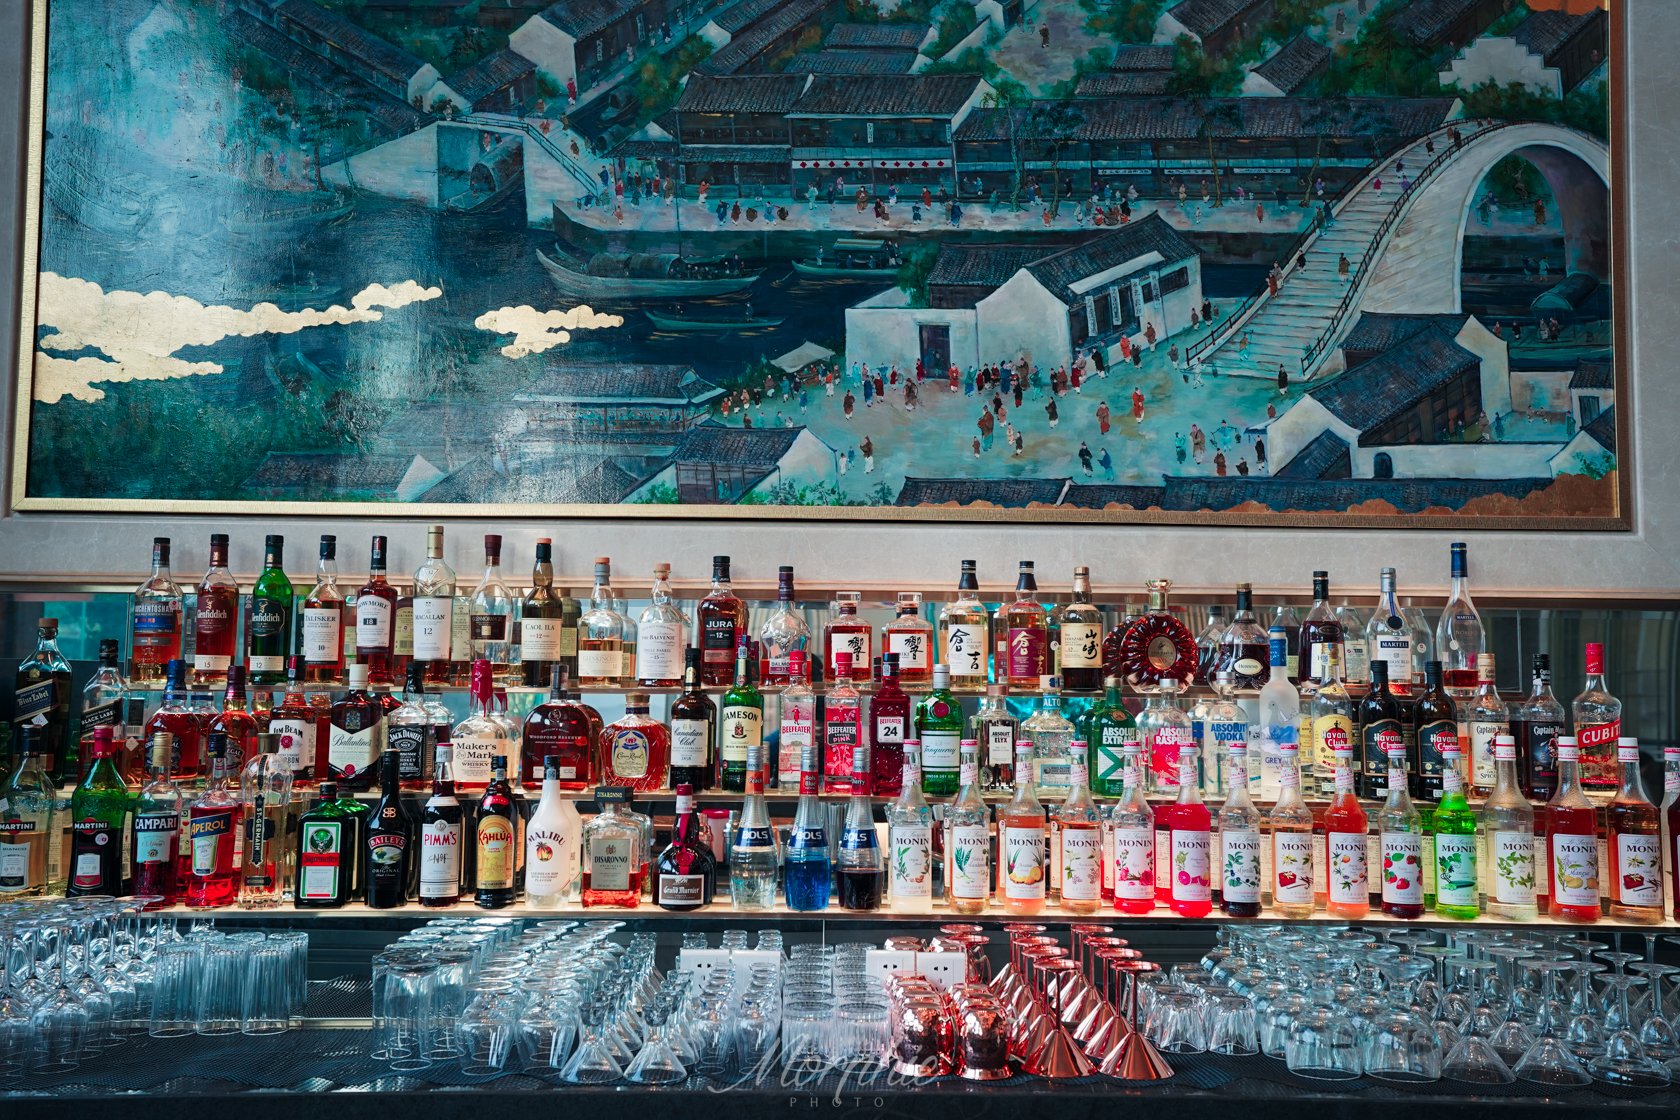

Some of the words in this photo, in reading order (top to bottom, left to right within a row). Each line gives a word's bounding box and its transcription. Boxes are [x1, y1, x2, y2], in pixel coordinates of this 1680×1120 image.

[358, 600, 389, 610] BOWMORE
[424, 627, 433, 635] 12
[525, 623, 543, 631] CAOL
[771, 660, 791, 668] DALMO
[1238, 662, 1259, 671] Hennessy
[17, 695, 32, 706] Blue
[32, 690, 49, 700] Label
[82, 715, 98, 725] BLACK
[723, 710, 758, 722] JAMESON
[273, 727, 284, 735] JIM
[285, 724, 303, 739] BEAM
[673, 726, 704, 738] Canadian
[782, 726, 811, 735] BEEFEATER
[828, 726, 857, 735] BEEFEATER
[884, 726, 898, 737] 24
[1103, 727, 1136, 736] ABSOLUT
[1211, 723, 1246, 733] ABSOLUT
[1477, 725, 1497, 735] Captain
[1533, 726, 1553, 736] Captain
[389, 731, 402, 743] JACK
[1215, 732, 1244, 742] VODKA
[1321, 730, 1350, 739] Havana
[1374, 733, 1402, 742] Havana
[1430, 734, 1458, 743] Havana
[1582, 724, 1620, 744] CUBIT
[332, 734, 372, 747] Ballantine's
[679, 737, 696, 747] Club
[833, 735, 851, 743] PINK
[456, 742, 497, 752] Maker's
[924, 745, 957, 756] Tanqueray
[226, 748, 241, 756] EGAL
[467, 752, 495, 760] Mark
[617, 752, 630, 760] Crown
[1480, 772, 1496, 780] SPICE
[597, 790, 623, 798] DISARONNO
[74, 822, 108, 830] MARTINI
[135, 817, 177, 830] CAMPARI
[191, 819, 226, 836] APEROL
[425, 831, 457, 846] PIMM'S
[478, 829, 513, 846] KAHLÚA
[529, 830, 565, 847] MALIBU
[742, 831, 769, 840] BOLS
[796, 831, 822, 841] BOLS
[843, 833, 868, 842] BOLS
[371, 836, 404, 847] BAILEYS
[895, 837, 930, 846] MONIN
[1009, 838, 1043, 847] MONIN
[1067, 839, 1100, 848] MONIN
[1119, 839, 1153, 848] MONIN
[1177, 840, 1211, 849] MONIN
[1386, 843, 1421, 852] MONIN
[304, 855, 339, 864] Jägermeister
[595, 855, 628, 864] DISARONNO
[664, 885, 680, 894] Grand
[680, 886, 700, 894] Marnier
